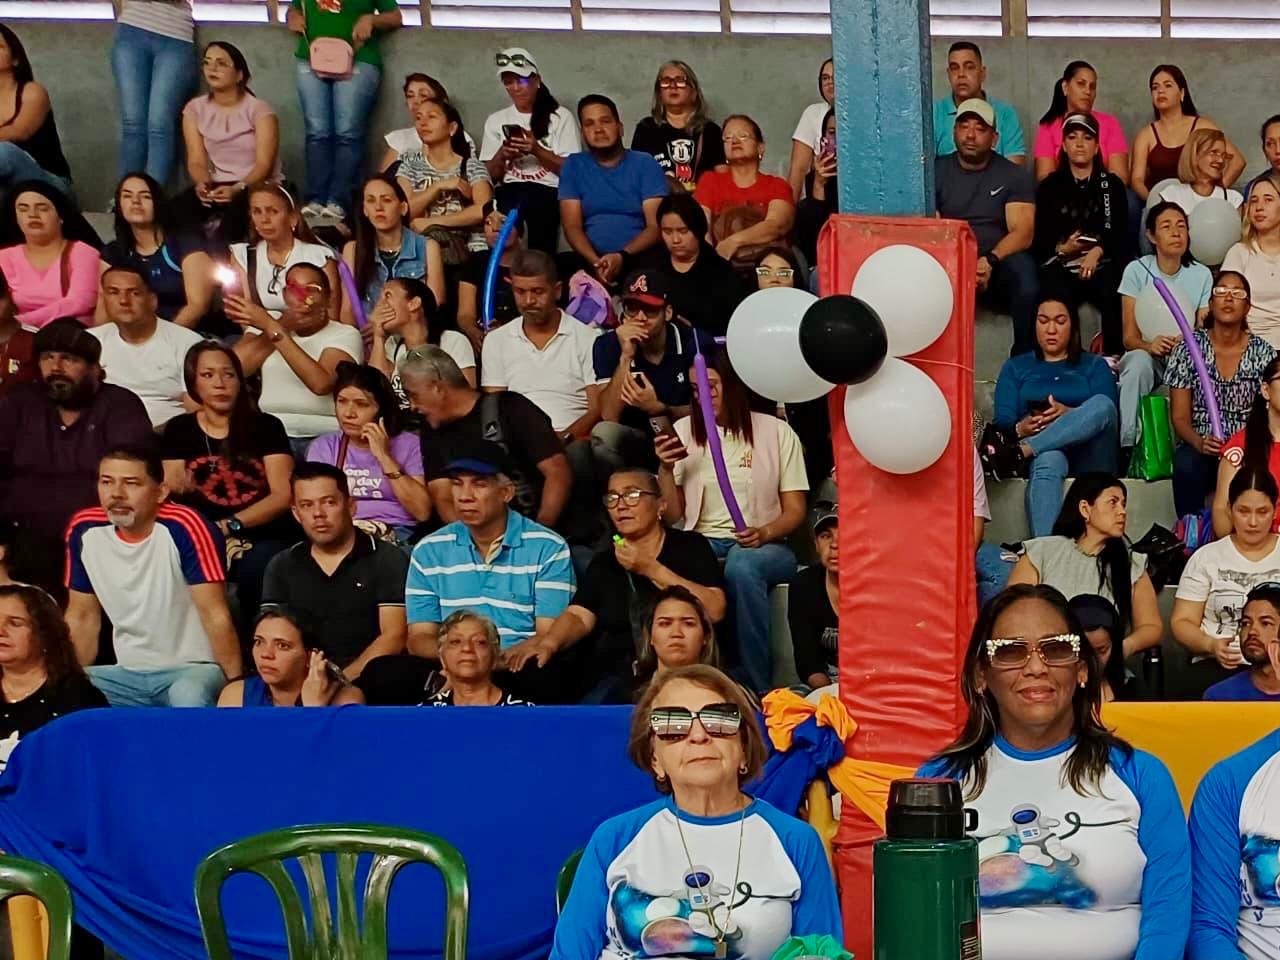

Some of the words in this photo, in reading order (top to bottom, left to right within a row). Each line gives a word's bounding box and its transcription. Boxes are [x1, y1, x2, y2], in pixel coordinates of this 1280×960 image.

[345, 468, 370, 477] one
[356, 476, 382, 489] day
[371, 489, 383, 499] a
